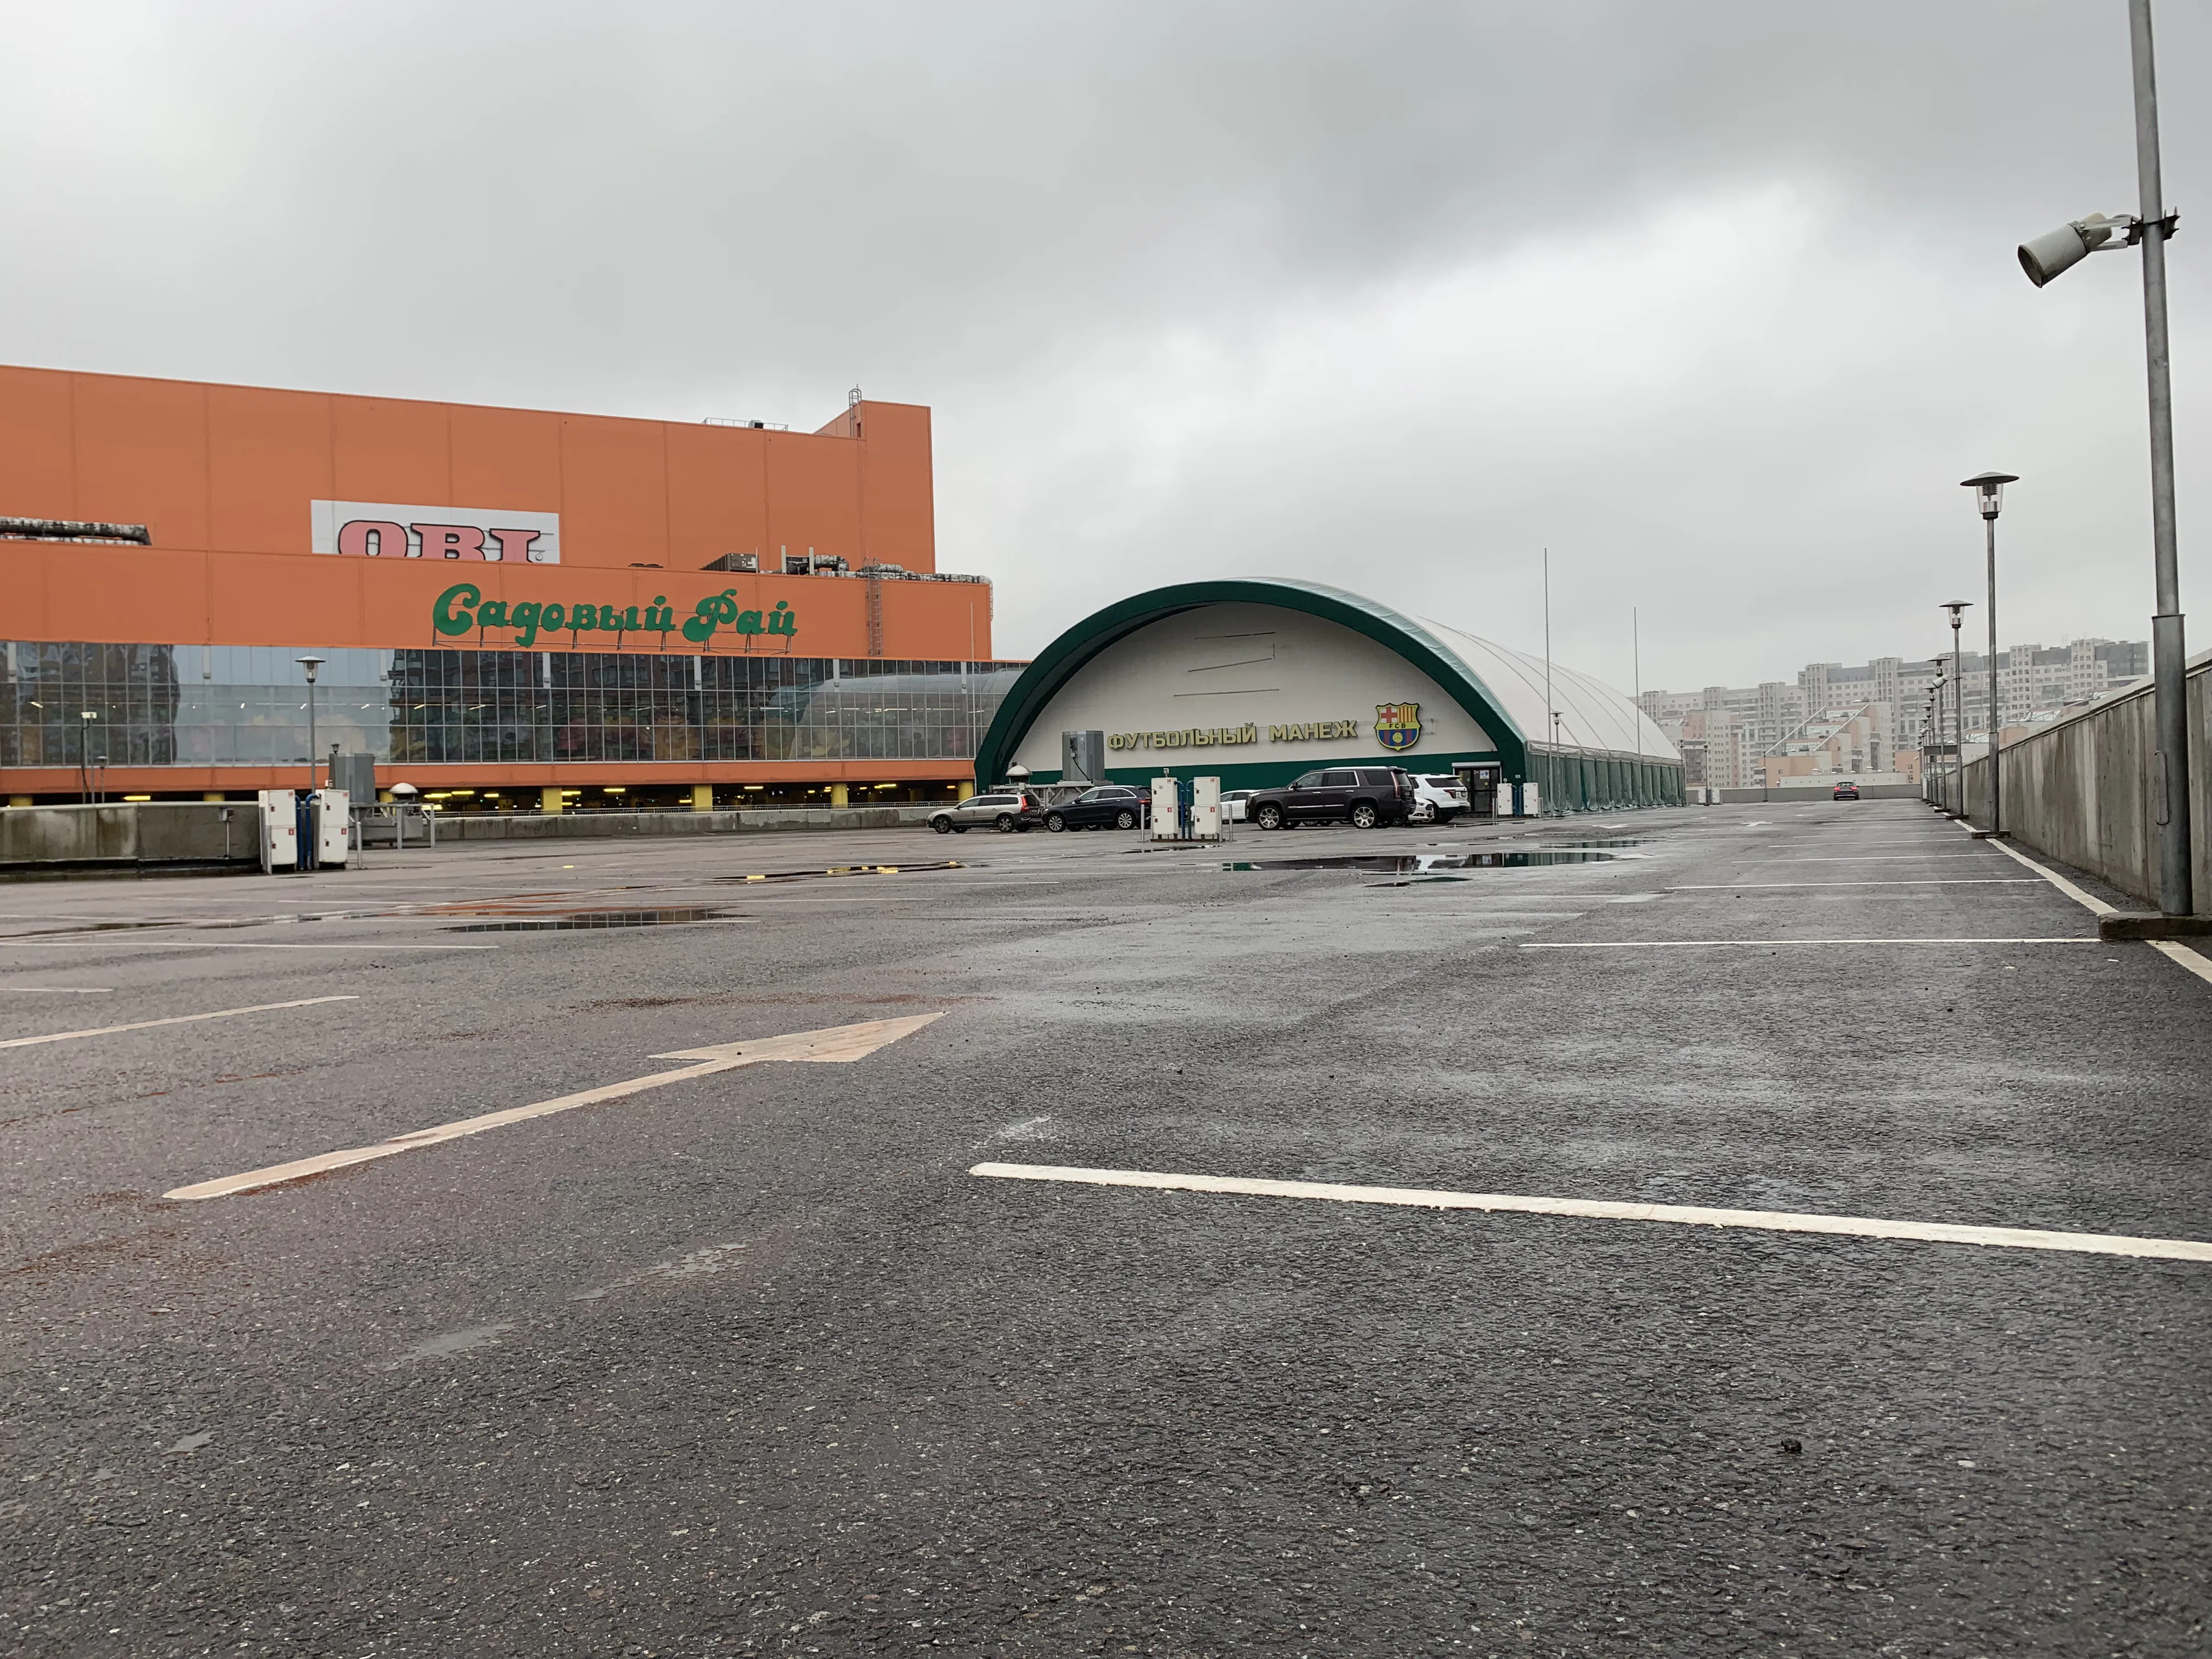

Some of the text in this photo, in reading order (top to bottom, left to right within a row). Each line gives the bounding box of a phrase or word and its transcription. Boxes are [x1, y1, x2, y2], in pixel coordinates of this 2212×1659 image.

[338, 519, 540, 563] OBI
[432, 583, 798, 647] Садовый Рай
[1107, 720, 1358, 749] ФУТБОЛЬНЫЙ МАНЕЖ
